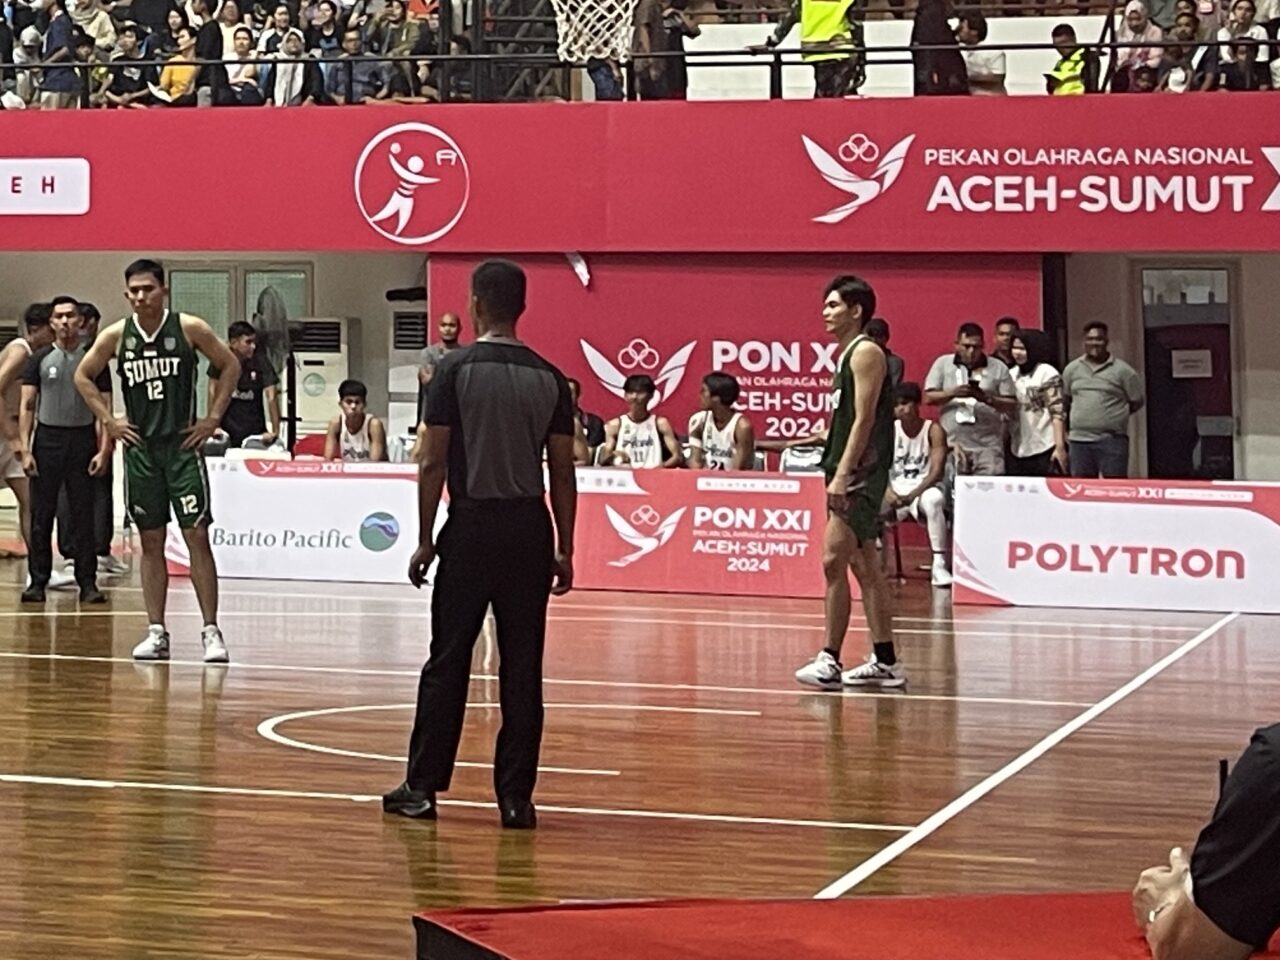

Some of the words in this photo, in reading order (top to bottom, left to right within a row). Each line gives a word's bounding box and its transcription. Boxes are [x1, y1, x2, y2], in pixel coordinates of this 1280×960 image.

[925, 148, 998, 166] PEKAN
[1004, 147, 1129, 166] OLAHRAGA
[1134, 146, 1254, 165] NASIONAL
[926, 175, 1254, 213] ACEH-SUMUT
[712, 340, 801, 373] PON
[123, 357, 181, 388] SUMUT
[145, 380, 164, 400] 12
[765, 417, 826, 437] 2024
[180, 495, 200, 515] 12
[694, 506, 756, 529] PON
[762, 508, 811, 531] XXI
[212, 528, 277, 547] Barito
[282, 528, 352, 549] Pacific
[693, 539, 809, 557] ACEH-SUMUT
[727, 557, 771, 572] 2024
